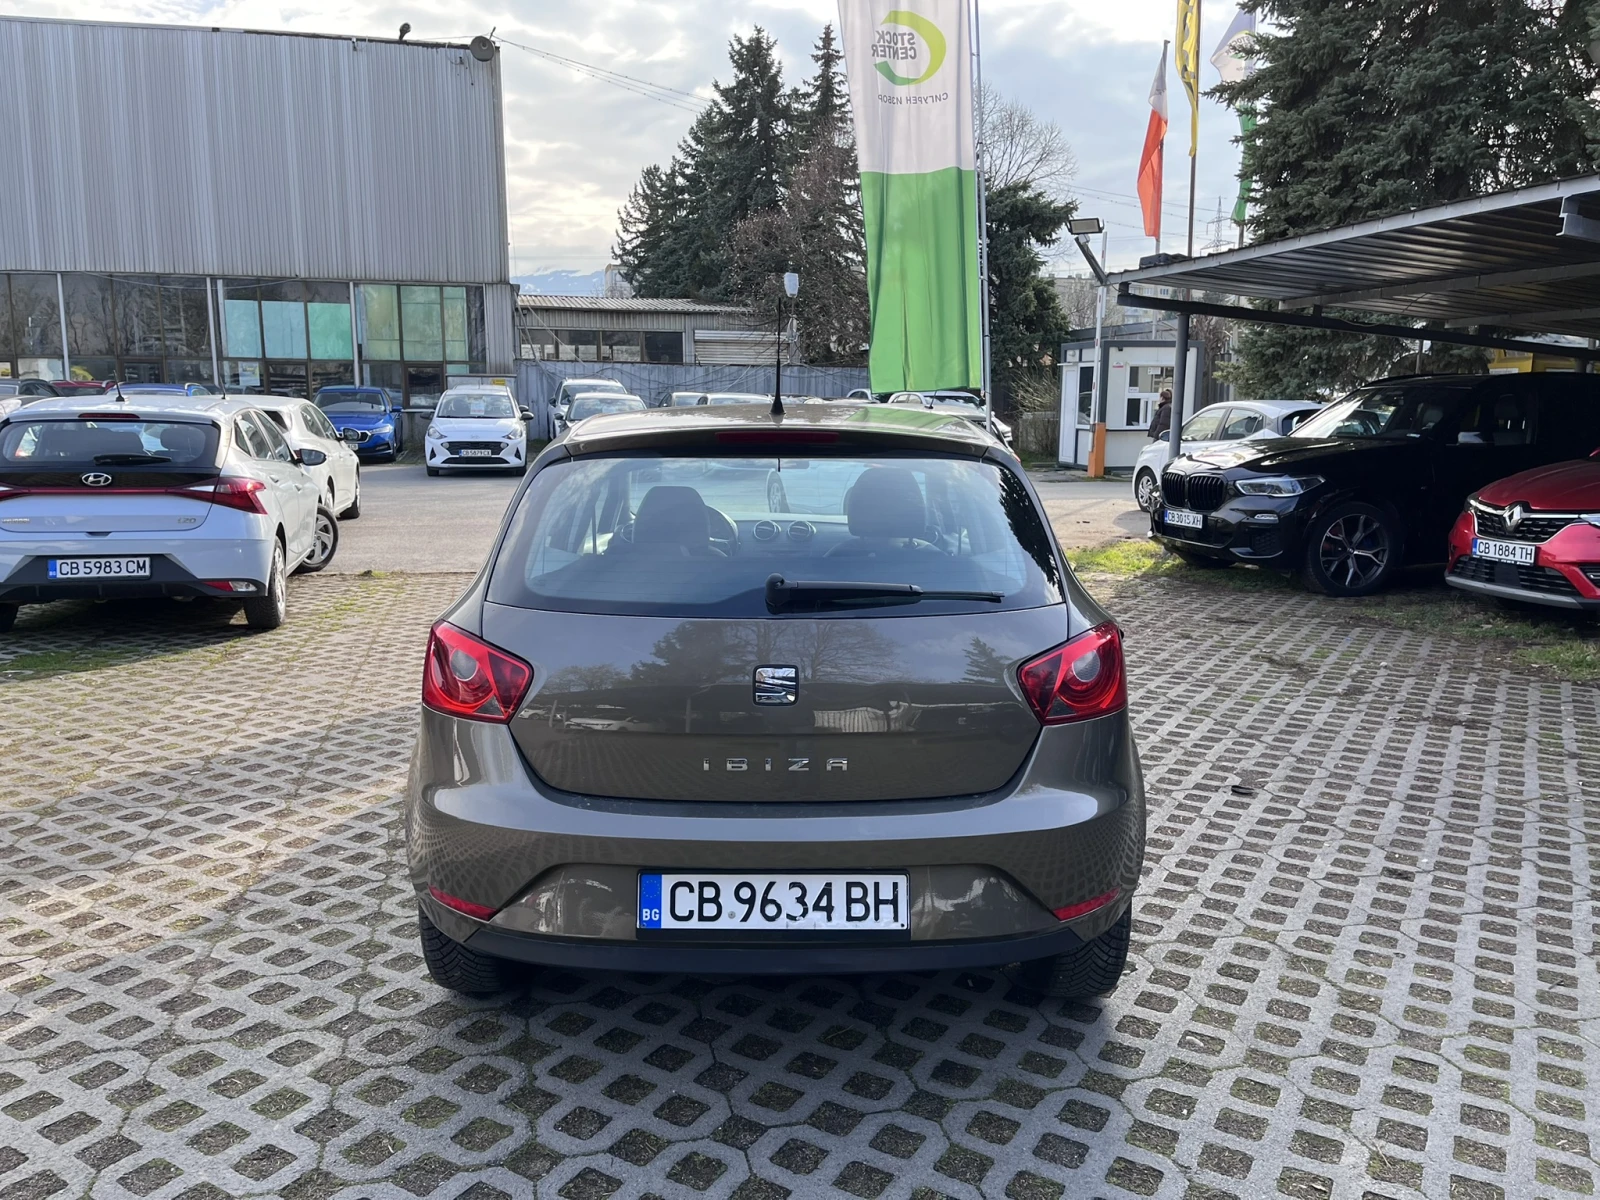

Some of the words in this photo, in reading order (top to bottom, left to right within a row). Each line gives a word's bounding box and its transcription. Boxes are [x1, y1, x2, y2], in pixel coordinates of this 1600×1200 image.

[1168, 511, 1175, 522] CB
[1176, 513, 1190, 525] 3015
[1478, 541, 1490, 554] CB
[1493, 543, 1516, 558] 1884
[1518, 546, 1533, 560] TH
[60, 561, 80, 575] CB
[83, 560, 122, 575] 5983
[125, 559, 147, 574] CM
[703, 758, 848, 771] IBIZA
[669, 881, 723, 922] CB
[733, 881, 835, 922] 9634
[845, 881, 899, 922] BH
[642, 908, 660, 921] BG
